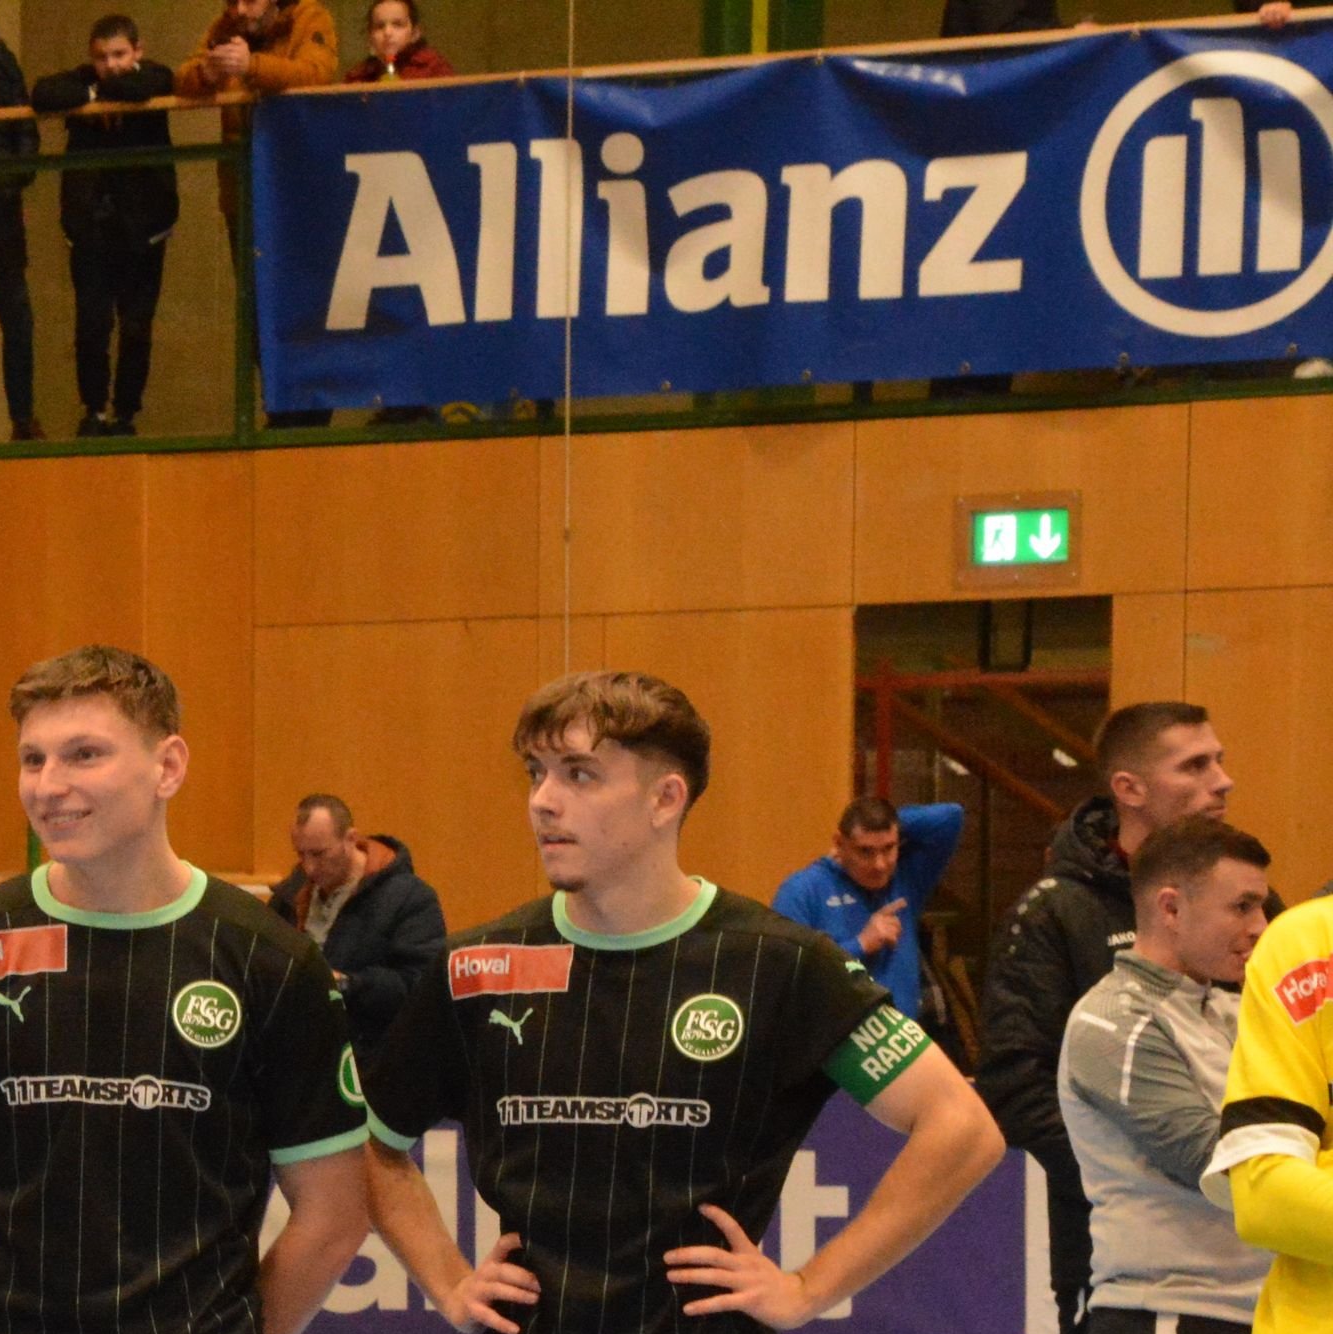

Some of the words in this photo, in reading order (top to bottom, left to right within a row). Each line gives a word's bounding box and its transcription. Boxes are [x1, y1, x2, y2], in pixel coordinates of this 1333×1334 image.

[325, 131, 1028, 331] Allianz
[455, 955, 510, 978] Hoval
[1283, 969, 1330, 1005] Hova
[850, 1015, 888, 1053] NO
[861, 1019, 927, 1082] RACIS
[0, 1074, 212, 1112] 11TEAMSPORTS
[496, 1092, 711, 1128] 11TEAMSPORTS
